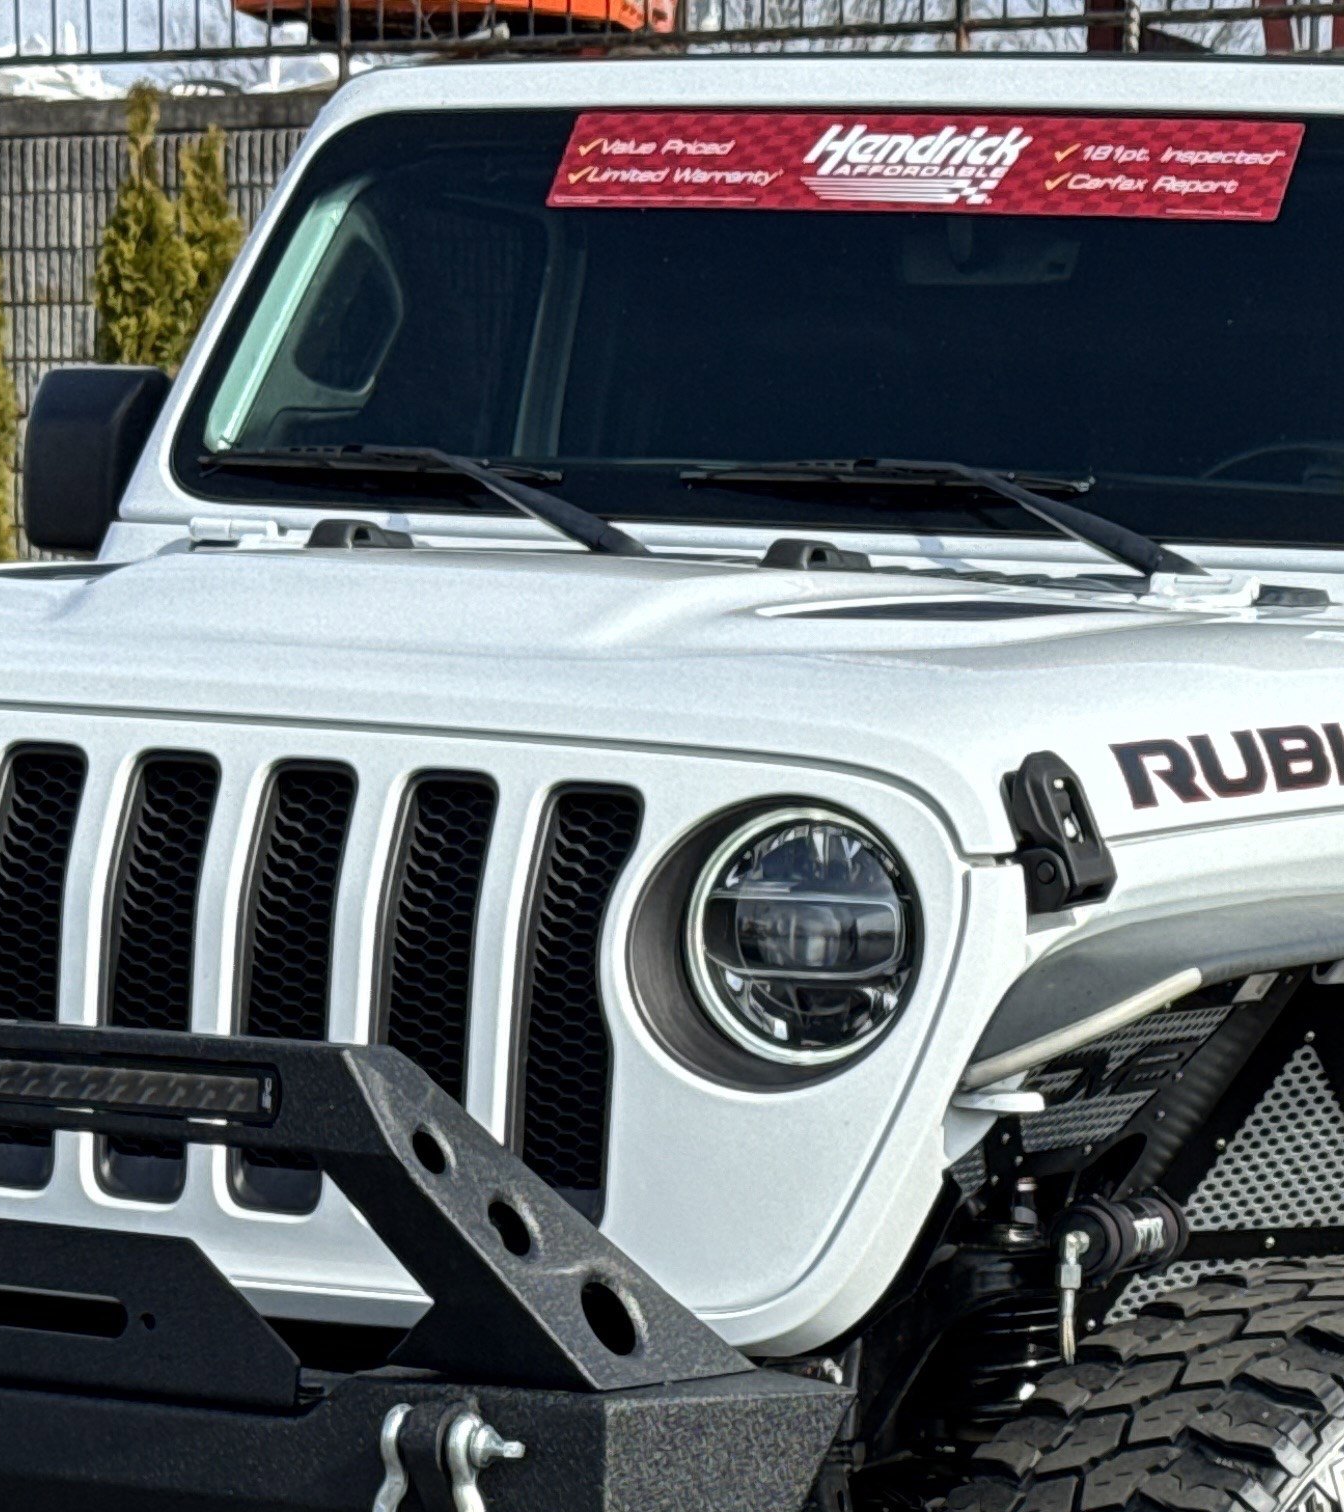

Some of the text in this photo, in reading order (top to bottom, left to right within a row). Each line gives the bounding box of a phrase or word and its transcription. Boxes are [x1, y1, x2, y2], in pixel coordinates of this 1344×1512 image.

[602, 138, 736, 155] Value Priced
[803, 124, 1034, 176] Hendrick
[587, 166, 670, 183] Limited
[832, 164, 1010, 178] AFFORDABLE
[1067, 173, 1239, 195] Carfax Report
